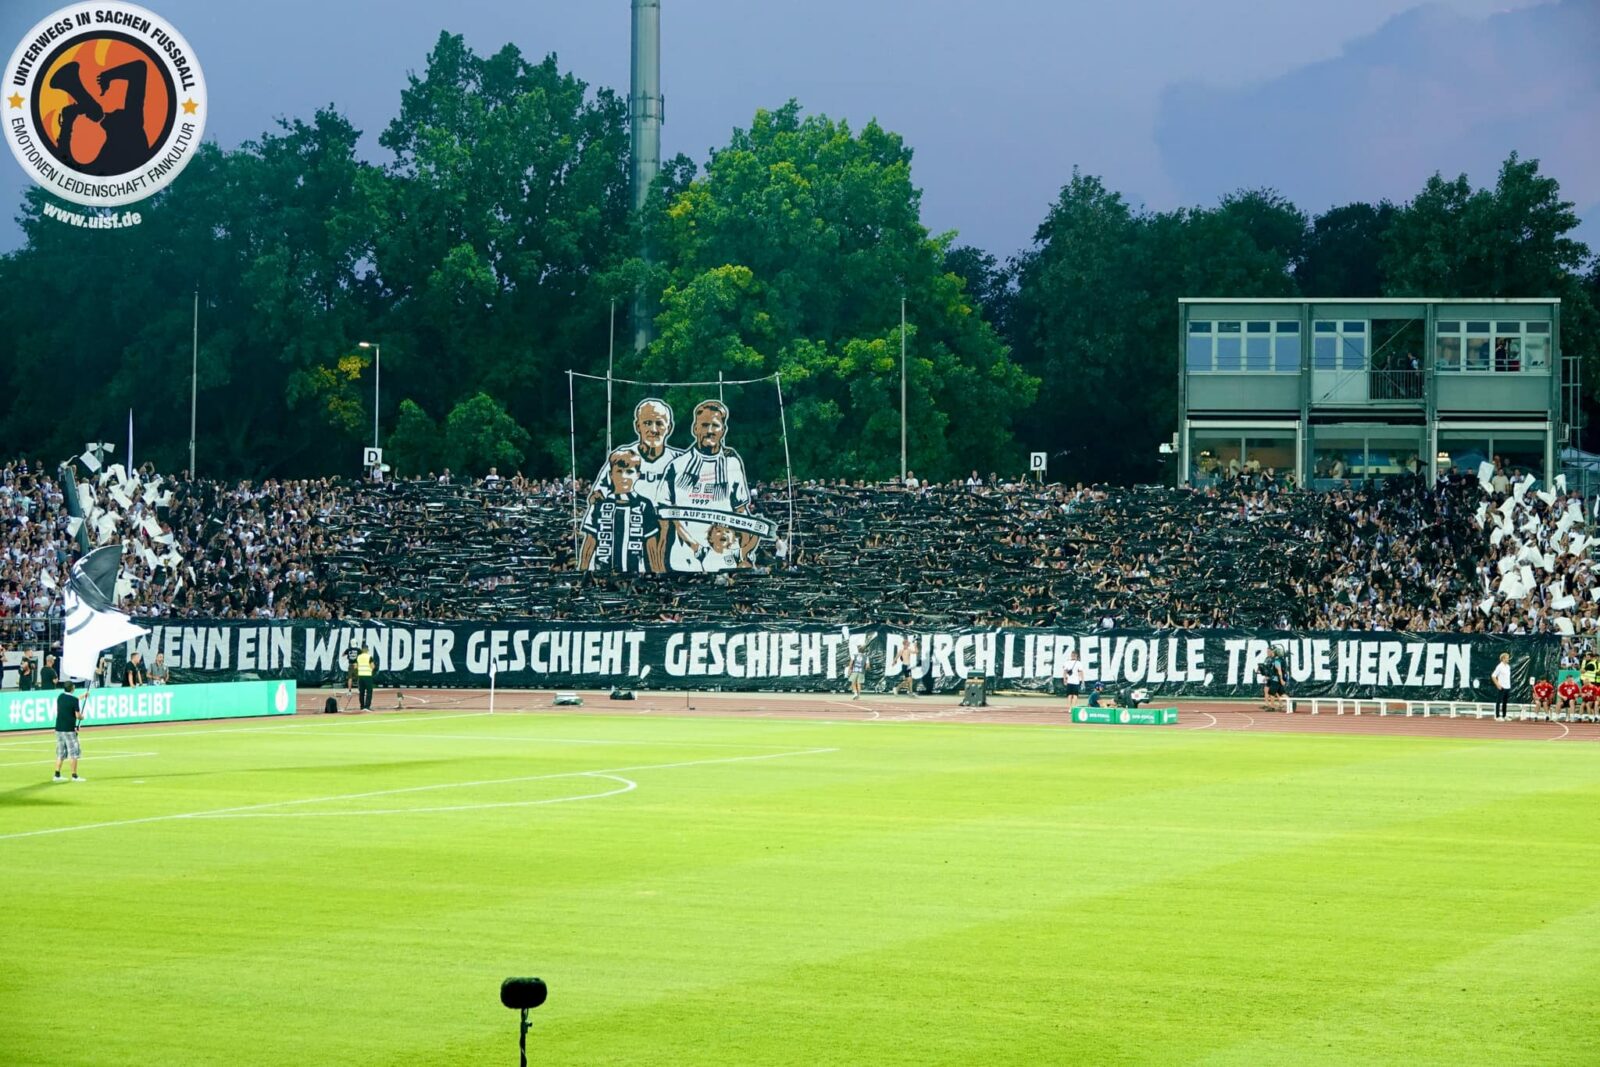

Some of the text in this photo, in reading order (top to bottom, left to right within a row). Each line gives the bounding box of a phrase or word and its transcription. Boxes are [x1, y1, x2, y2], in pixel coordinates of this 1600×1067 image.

[368, 450, 378, 463] D
[1033, 455, 1043, 468] D
[630, 506, 644, 537] LIGA
[683, 510, 727, 522] AUFSTIEG
[729, 517, 753, 528] 2024
[597, 503, 616, 564] AUFSTIEG
[126, 625, 231, 670] WENN
[237, 626, 292, 671] EIN
[304, 627, 456, 674] WUNDER
[466, 630, 651, 680] GESCHIEHT,
[885, 632, 997, 680] DURCH
[1336, 640, 1480, 690] HERZEN.
